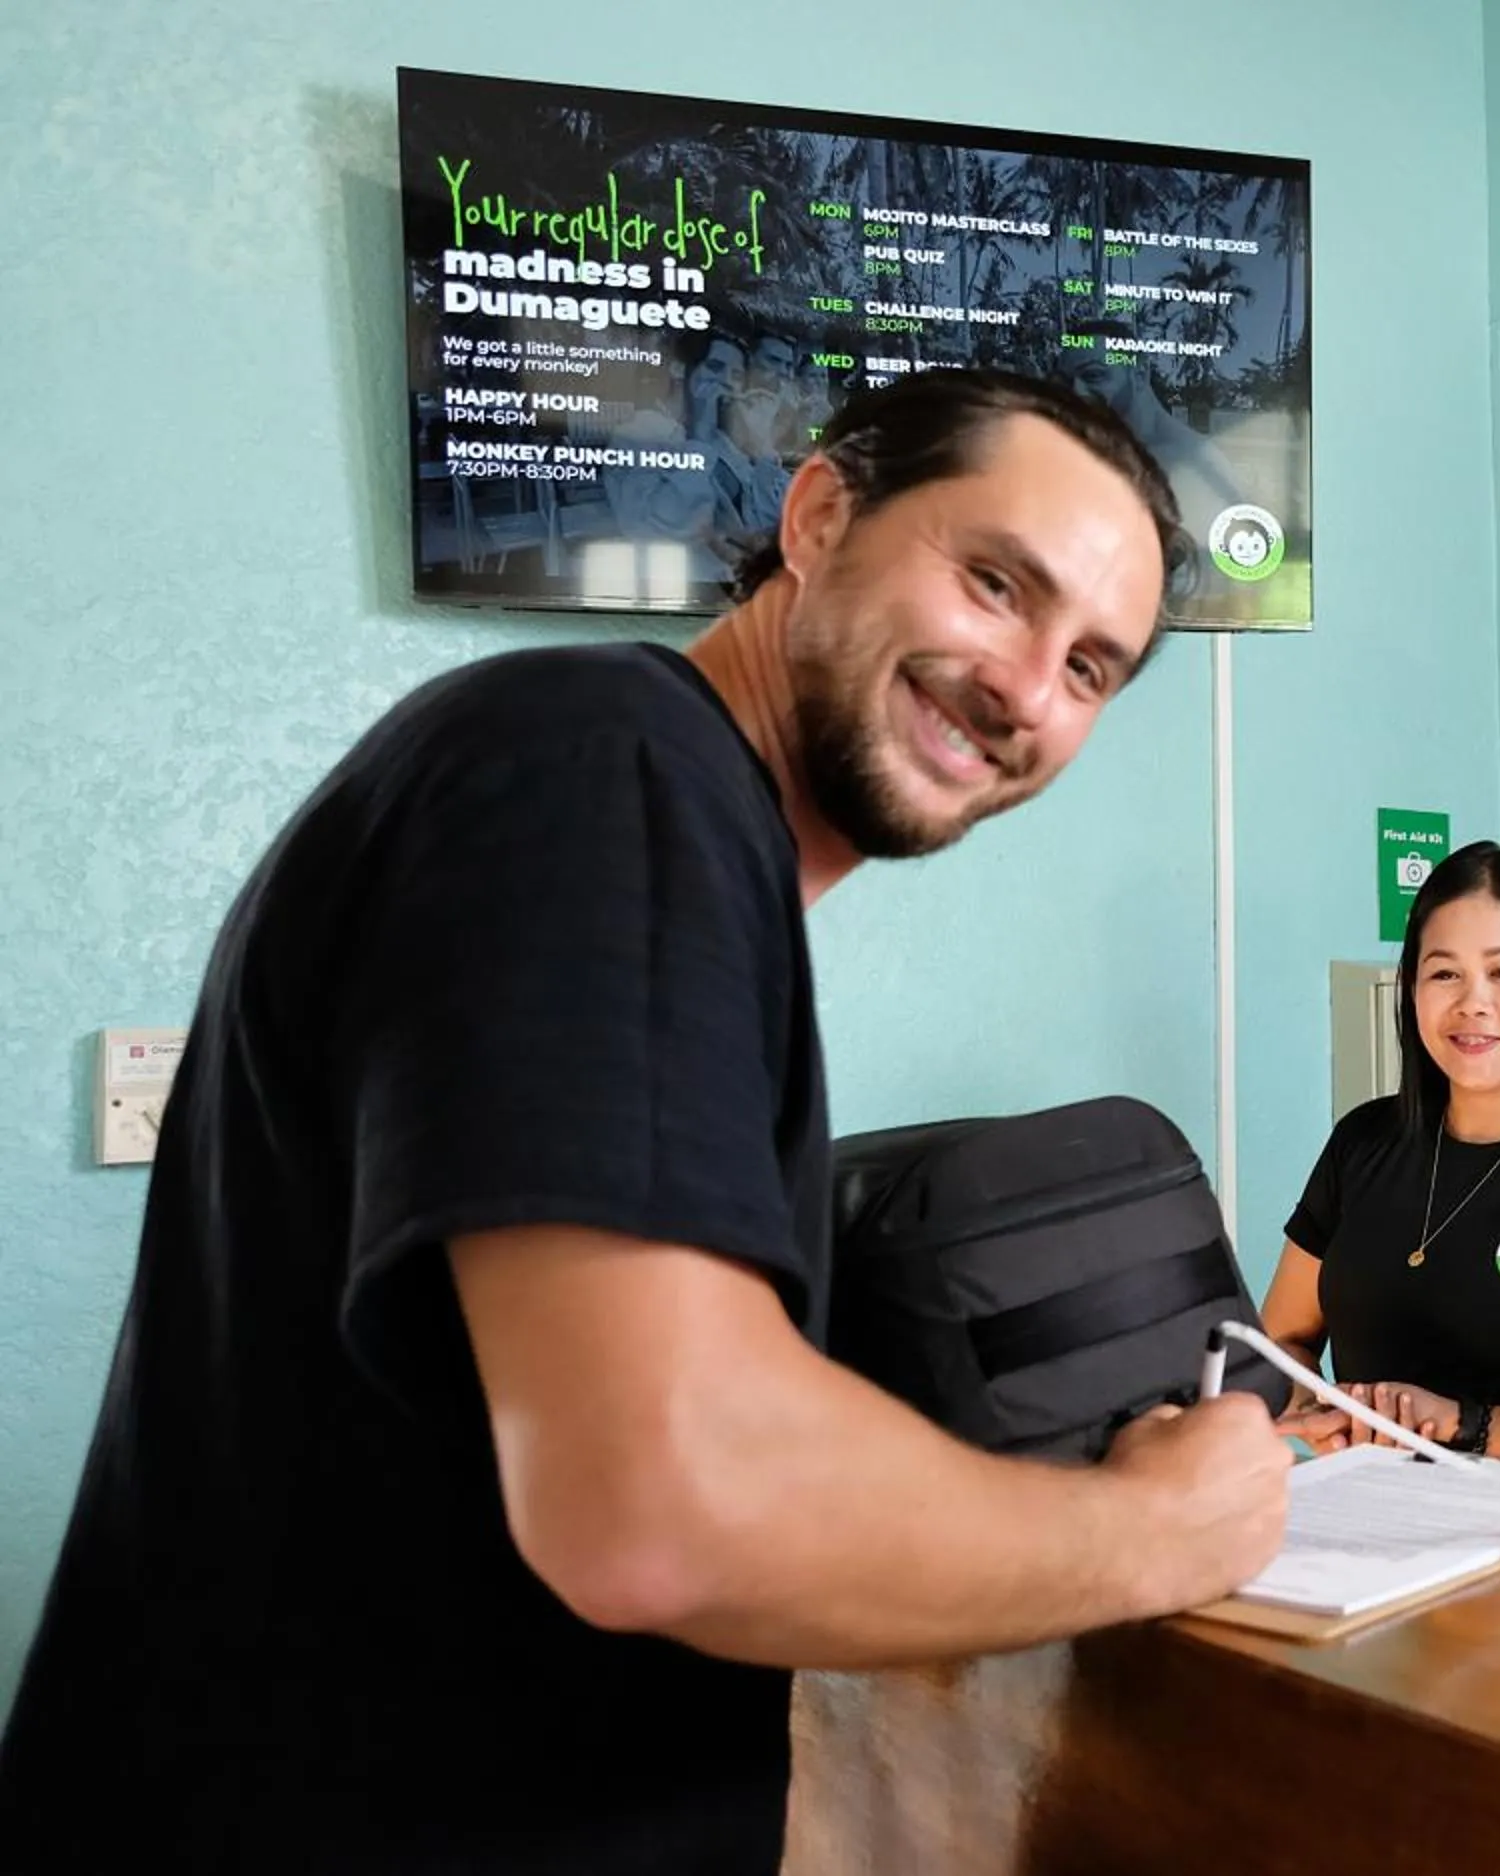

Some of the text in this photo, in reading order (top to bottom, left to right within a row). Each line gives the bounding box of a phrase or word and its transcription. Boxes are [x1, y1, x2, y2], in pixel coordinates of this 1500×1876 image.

[438, 155, 765, 282] Your regular dose of
[809, 203, 1050, 236] MON MOJITO MASTERCLASS
[863, 224, 899, 239] 6PM
[1067, 226, 1259, 254] FRI BATTLE OF THE SEXES
[864, 245, 945, 264] PUB QUIZ
[443, 249, 705, 293] madness in
[864, 262, 900, 276] 8PM
[1063, 280, 1232, 305] SAT MINUTE TO WIN IT
[443, 281, 711, 331] Dumaguete
[809, 297, 1021, 325] TUES CHALLENGE NIGHT
[865, 318, 923, 333] 8:30PM
[443, 335, 661, 366] We got a little something
[1061, 335, 1223, 358] SUN KARAOKE NIGHT
[443, 351, 600, 376] for every monkey!
[812, 353, 854, 369] WED
[865, 357, 911, 373] BEER
[445, 387, 600, 413] HAPPY HOUR
[445, 406, 538, 427] 1PM-6PM
[447, 441, 705, 471] MONKEY PUNCH HOUR
[447, 460, 597, 481] 7:30PM-8:30PM
[1383, 829, 1443, 845] First Aid Kit
